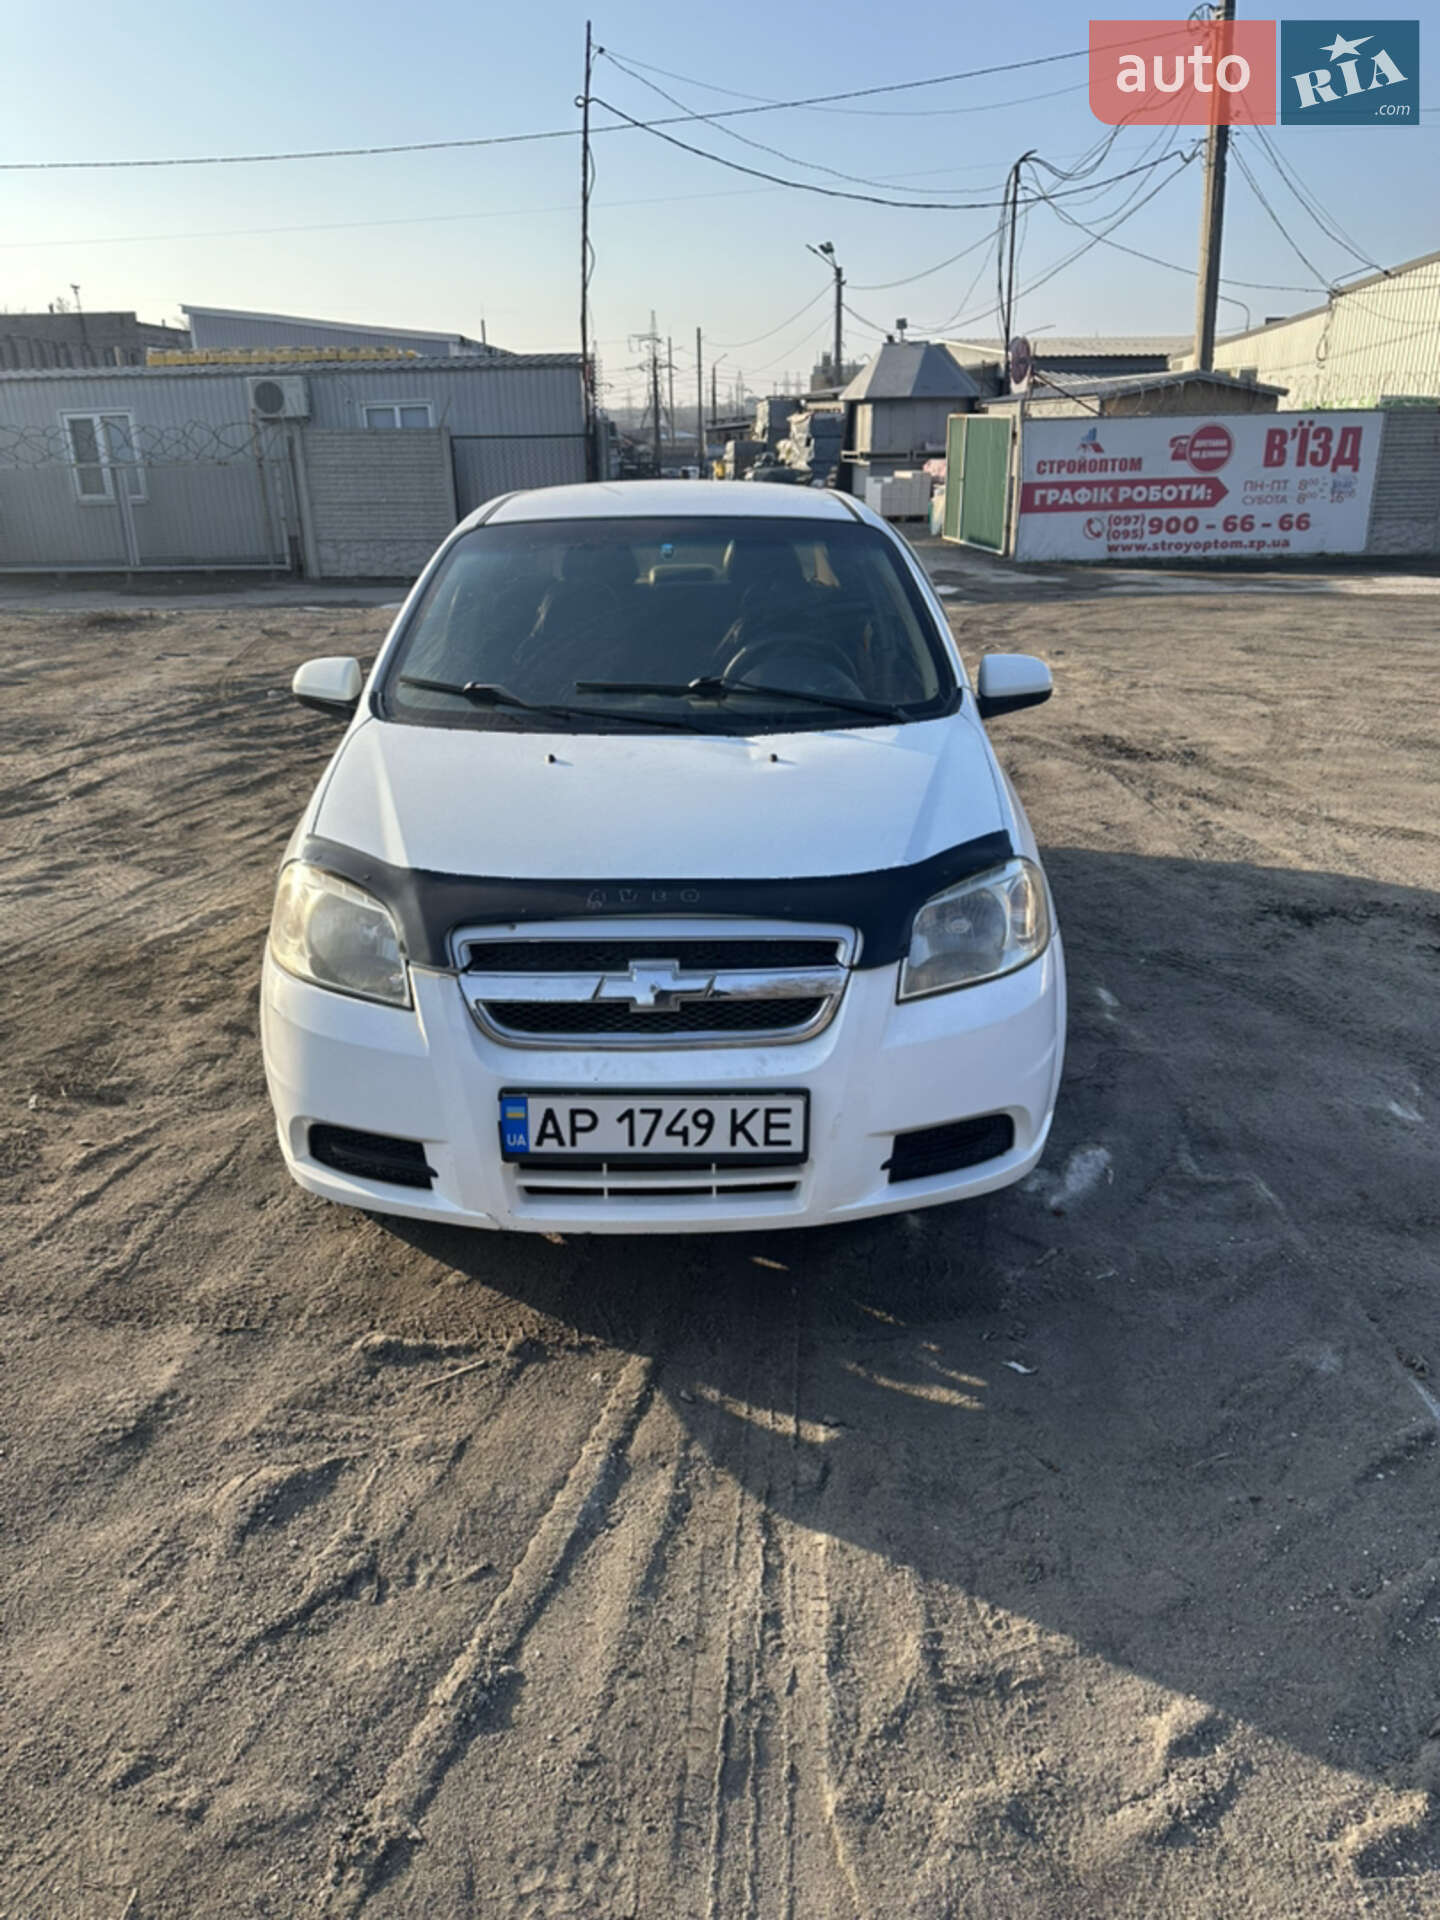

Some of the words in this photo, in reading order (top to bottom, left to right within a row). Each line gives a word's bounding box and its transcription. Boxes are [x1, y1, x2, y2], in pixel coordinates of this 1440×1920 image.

[1036, 456, 1143, 475] СТРОЙОПТОМ
[1033, 485, 1114, 507] ГРАФІК
[1117, 483, 1213, 504] РОБОТИ:
[1106, 527, 1145, 541] (095)
[1107, 513, 1146, 528] (097)
[1148, 515, 1199, 535] 900
[1222, 513, 1255, 533] 66
[1278, 512, 1311, 532] 66
[1106, 537, 1290, 553] www.stroyoptom.zp.ua
[506, 1133, 527, 1148] UA
[535, 1108, 599, 1148] AP
[616, 1108, 716, 1148] 1749
[730, 1108, 793, 1148] KE
